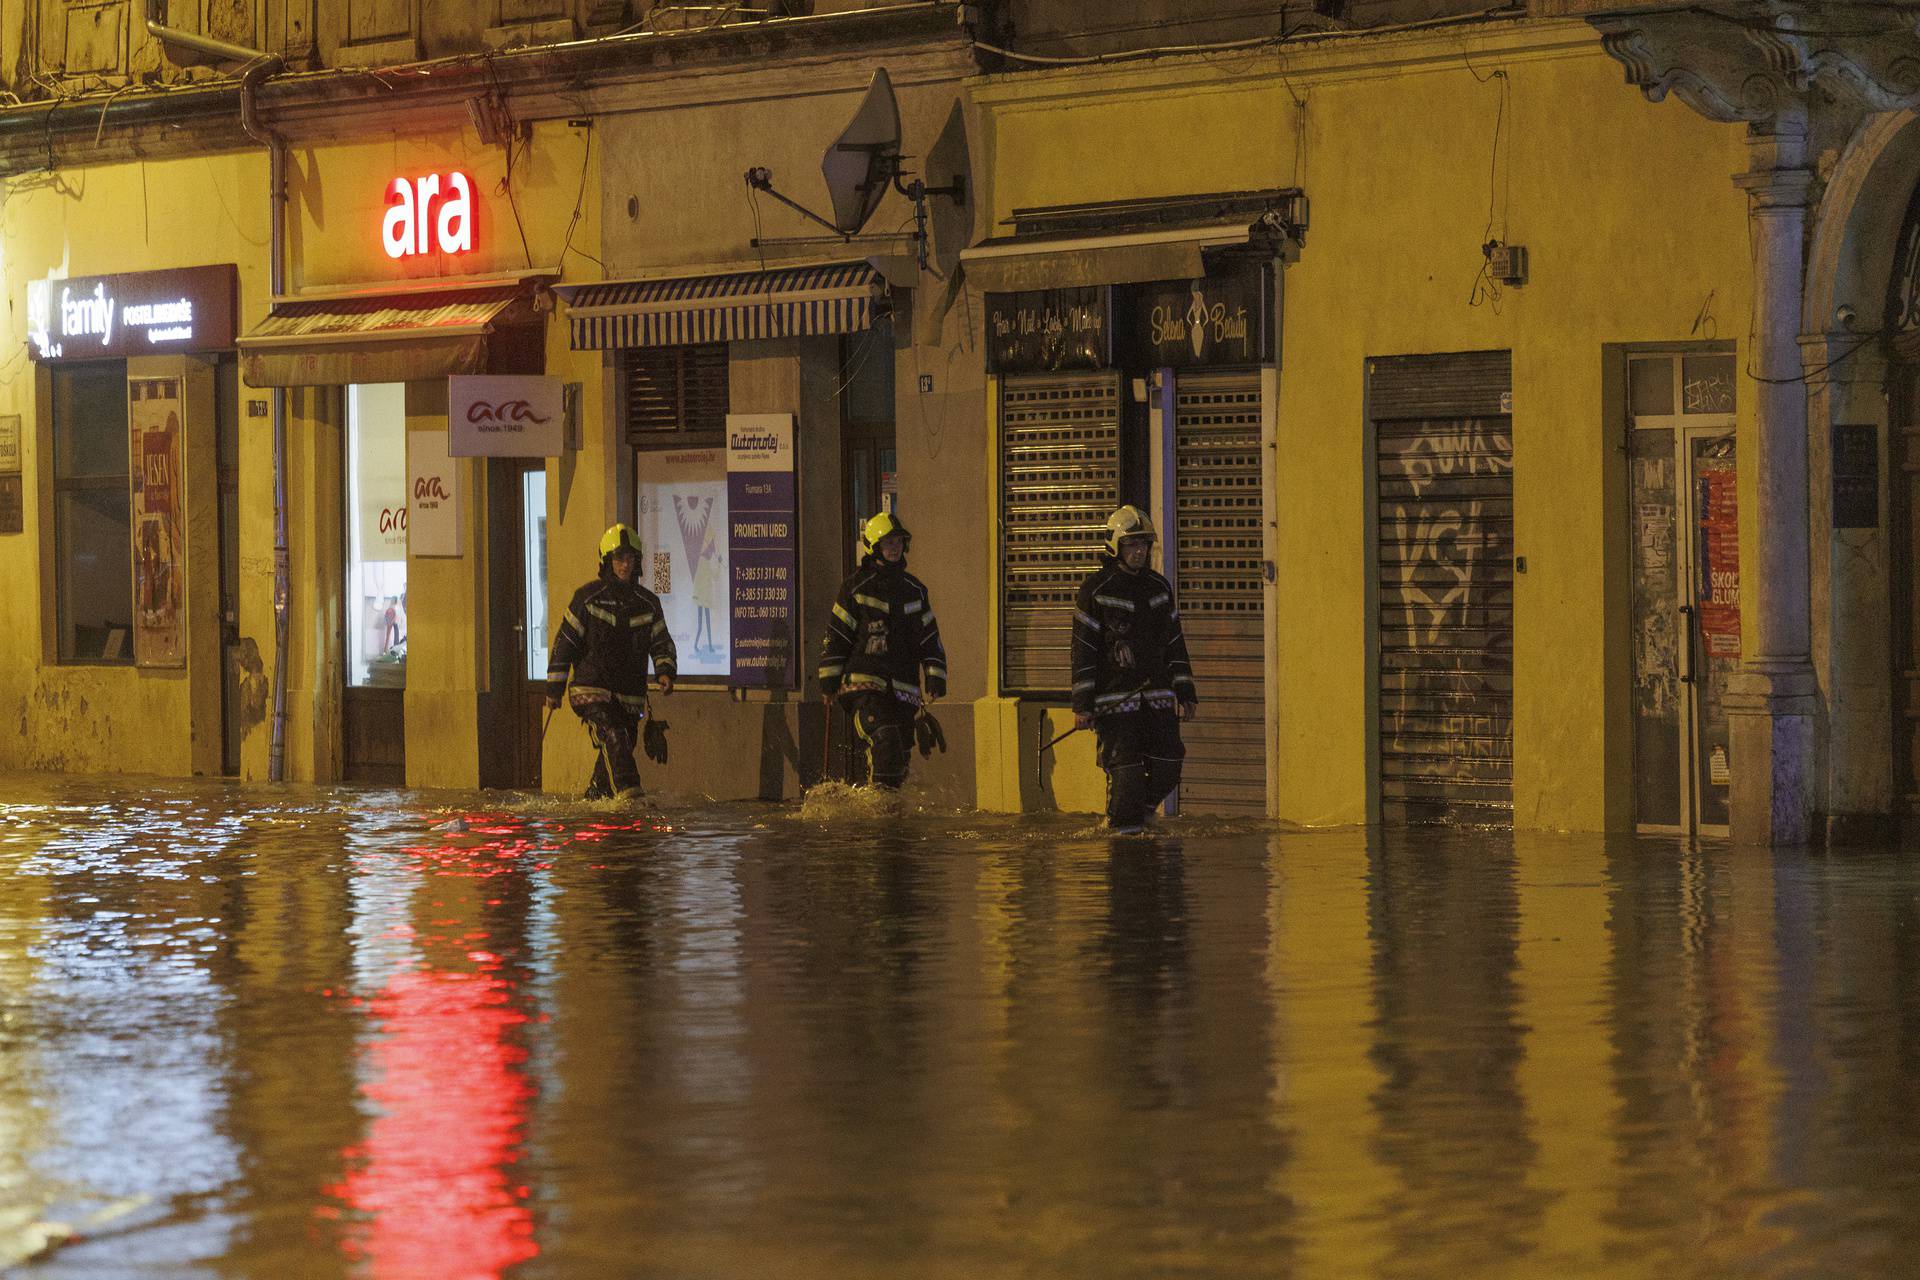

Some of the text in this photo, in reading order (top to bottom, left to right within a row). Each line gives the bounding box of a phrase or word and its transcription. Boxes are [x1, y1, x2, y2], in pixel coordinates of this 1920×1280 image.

[382, 170, 473, 258] ara
[61, 283, 114, 345] family
[1210, 302, 1247, 357] Beauty
[466, 400, 547, 424] ara
[415, 476, 450, 500] ara
[734, 523, 788, 538] PROMETNI URED
[1711, 567, 1739, 588] ŠKOL
